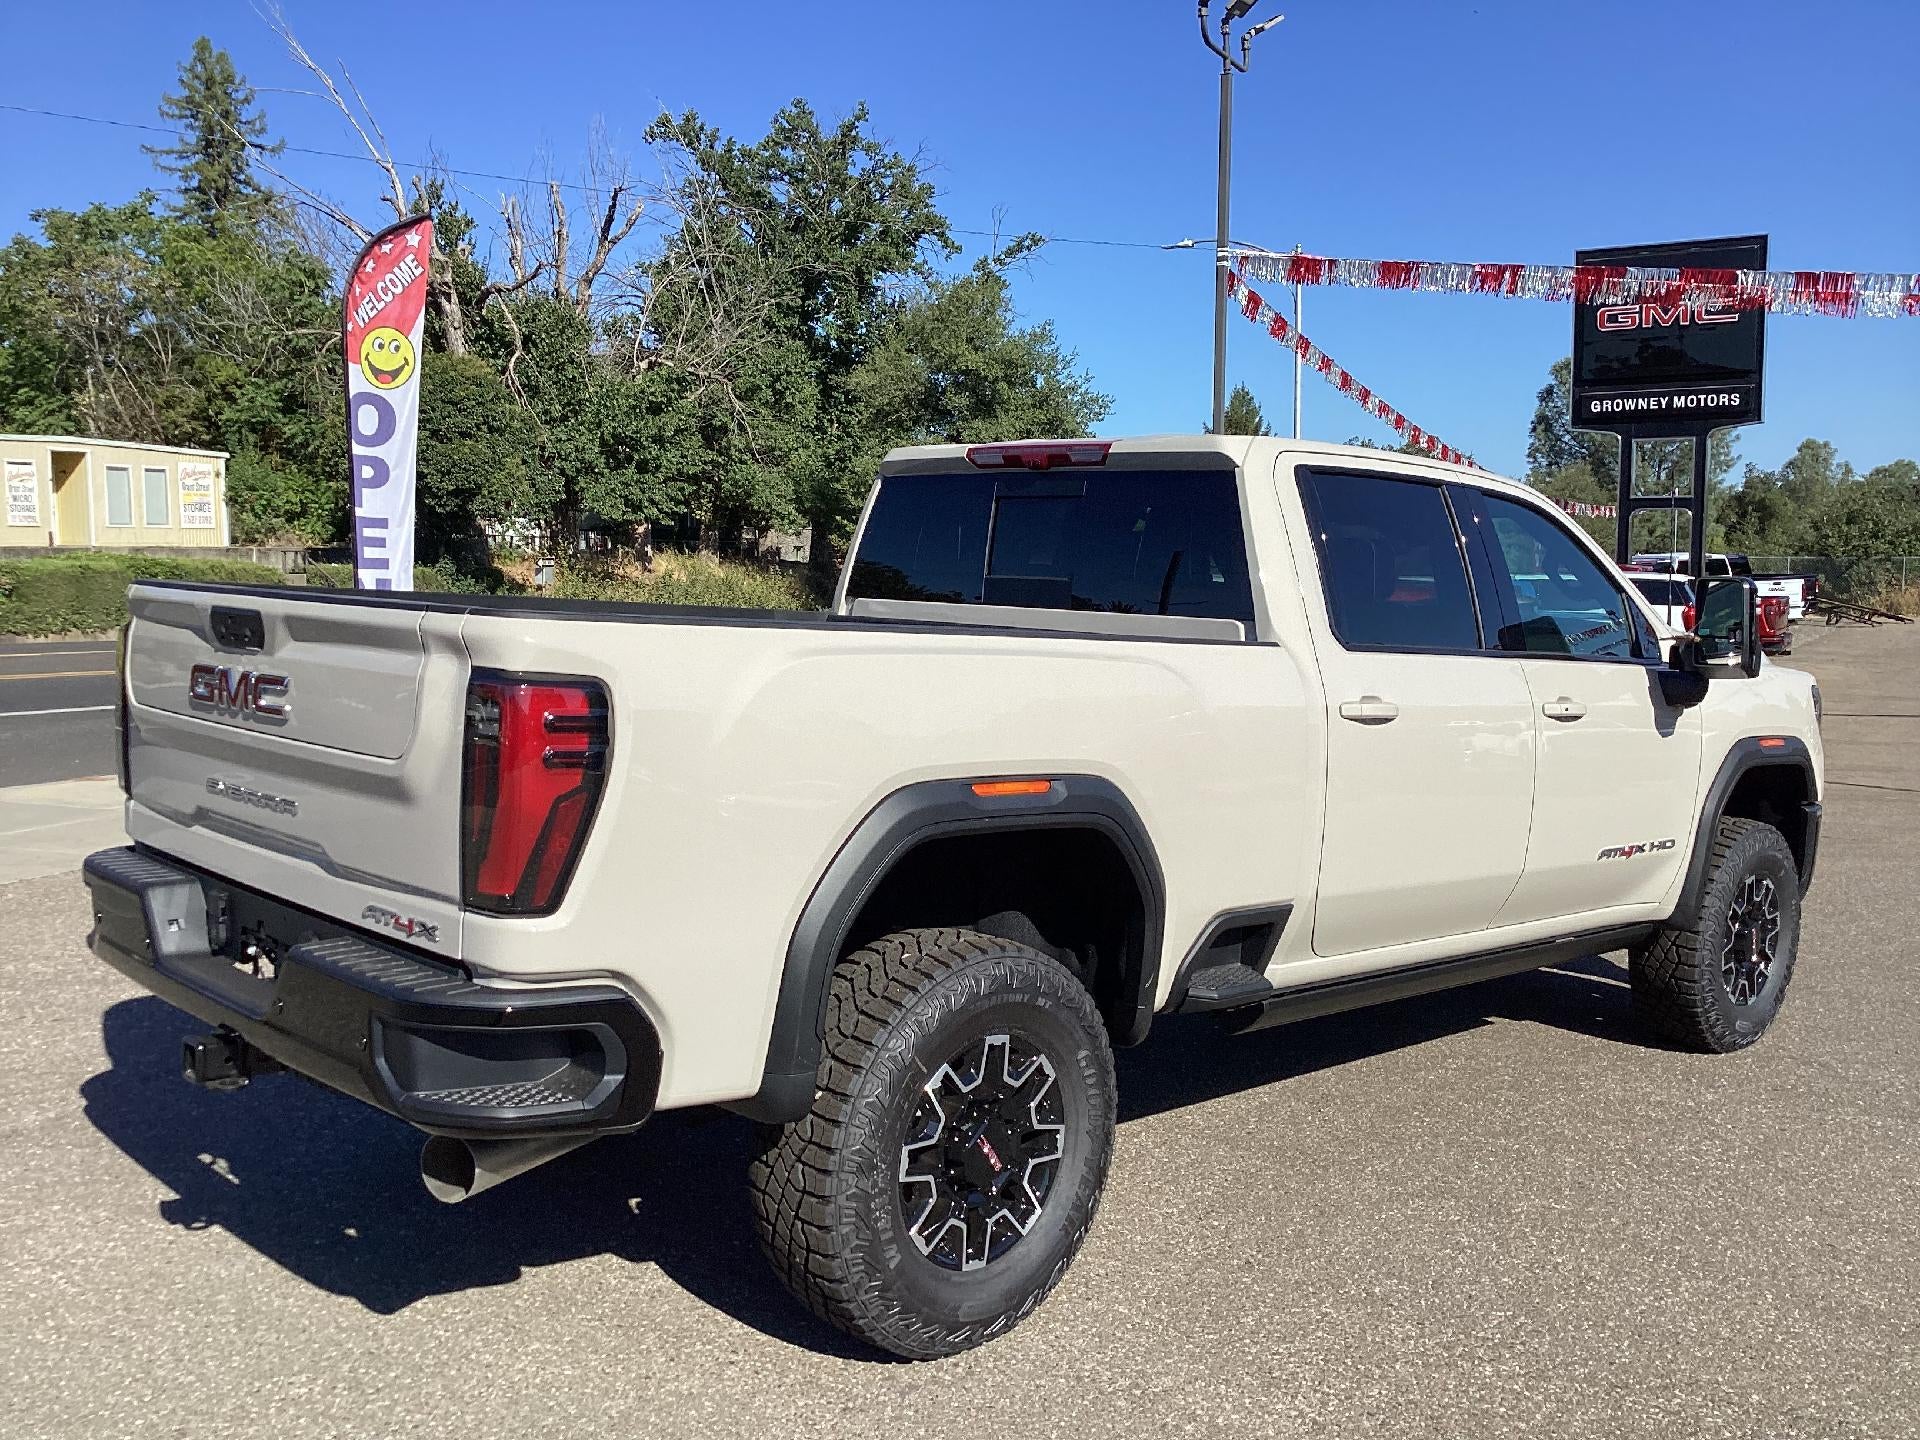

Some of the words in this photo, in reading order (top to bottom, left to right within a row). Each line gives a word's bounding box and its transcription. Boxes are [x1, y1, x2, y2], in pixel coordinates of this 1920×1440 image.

[353, 252, 425, 329] WELCOME
[1597, 301, 1740, 332] GMC
[1590, 397, 1669, 413] GROWNEY
[1673, 393, 1740, 408] MOTORS
[350, 391, 397, 591] OPE
[9, 504, 36, 513] STORAGE
[183, 503, 212, 513] STORAGE
[190, 664, 289, 718] GMC
[1597, 843, 1646, 861] AT4X
[1648, 838, 1676, 853] HD
[361, 904, 440, 944] AT4X
